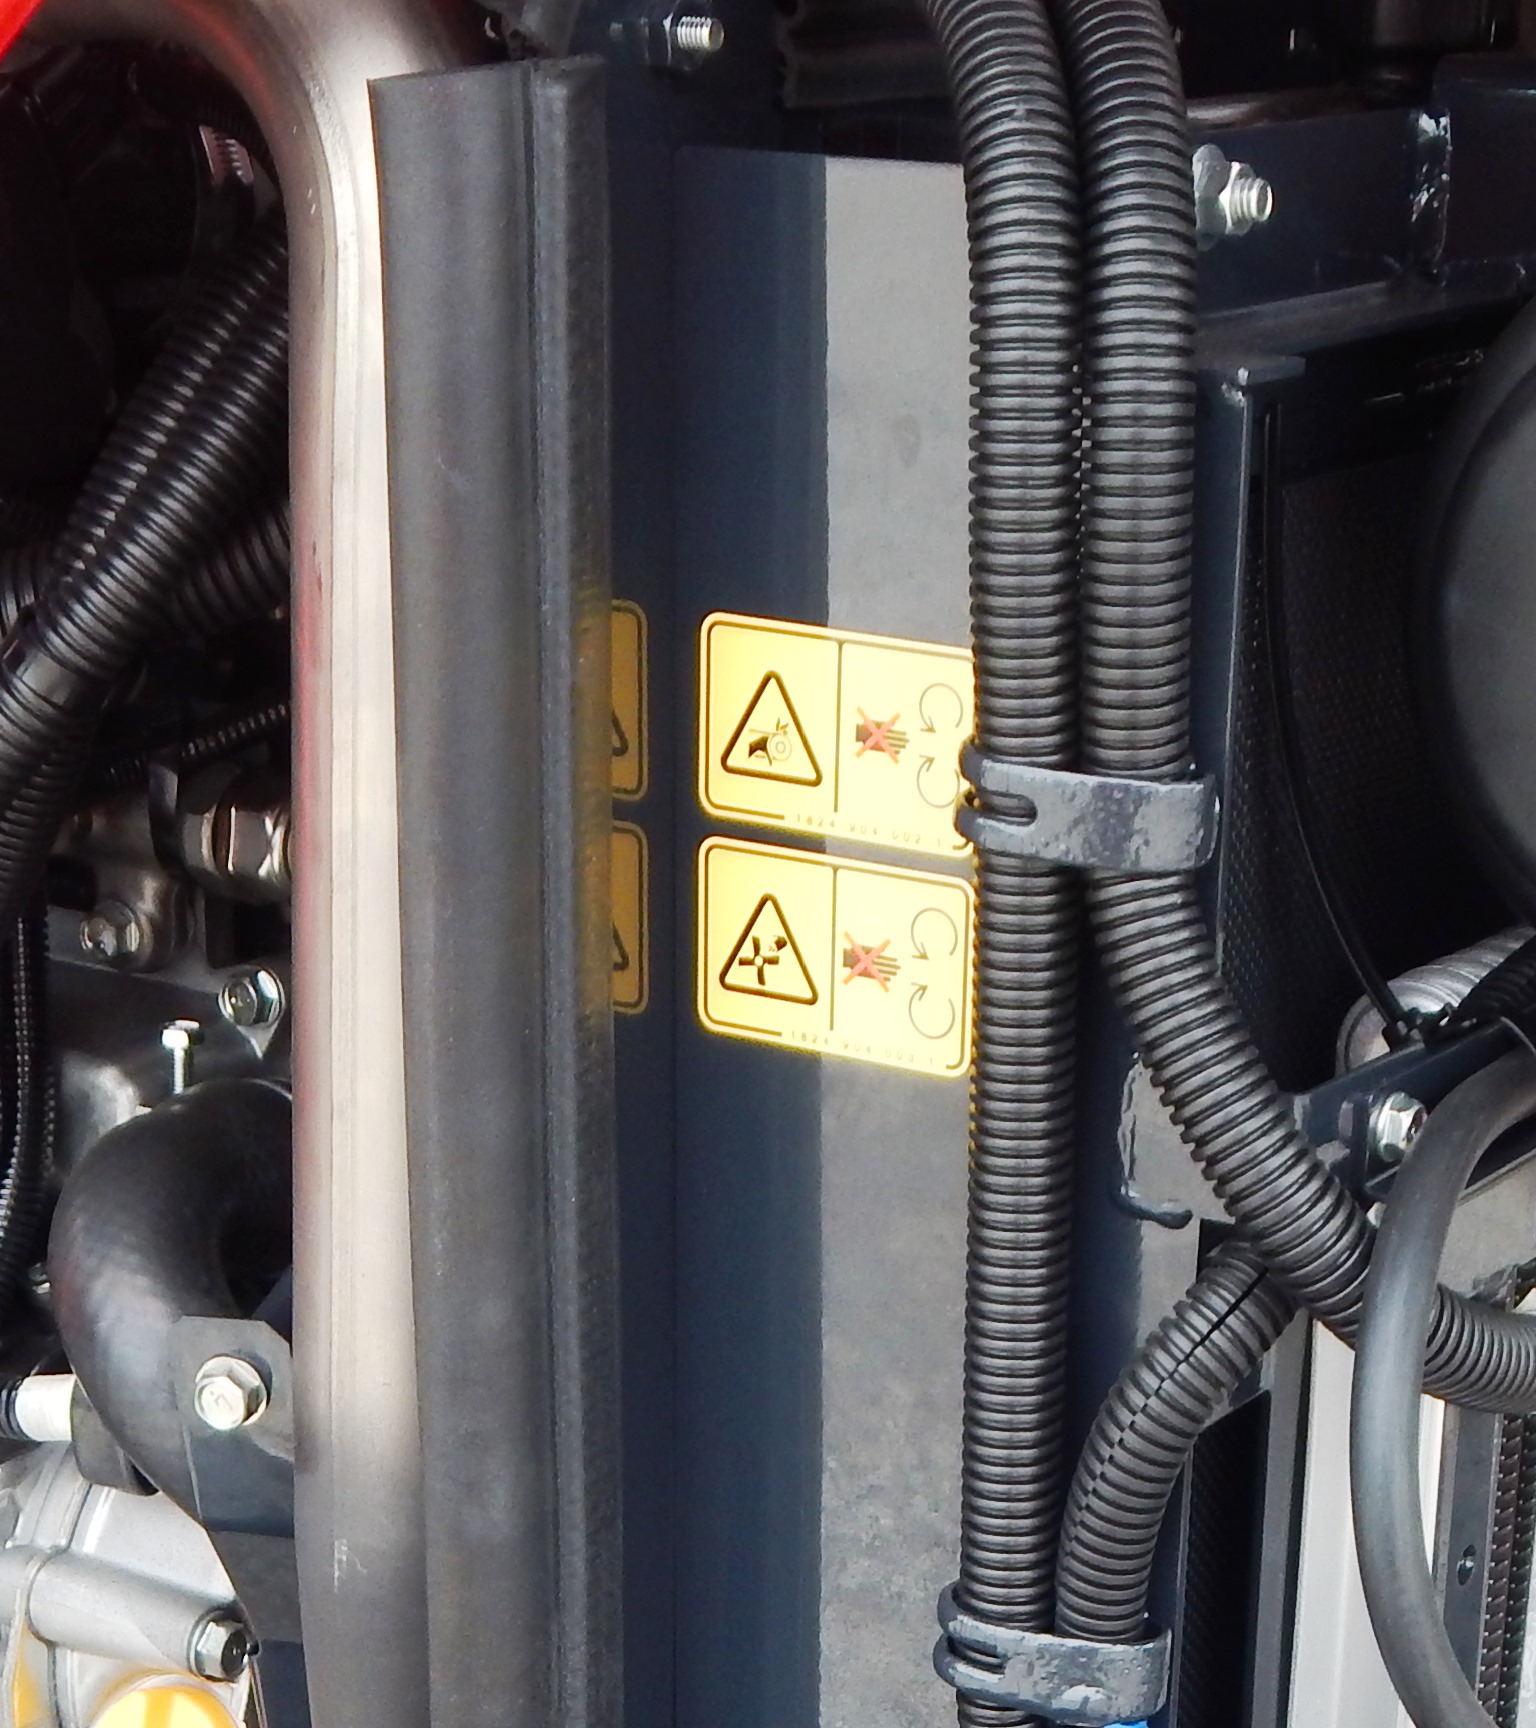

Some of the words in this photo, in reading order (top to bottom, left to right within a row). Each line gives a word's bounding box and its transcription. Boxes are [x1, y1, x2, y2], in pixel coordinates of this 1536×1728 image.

[796, 813, 836, 828] 1824
[849, 823, 878, 836] 904
[790, 1030, 830, 1045] 1824
[843, 1041, 872, 1054] 904
